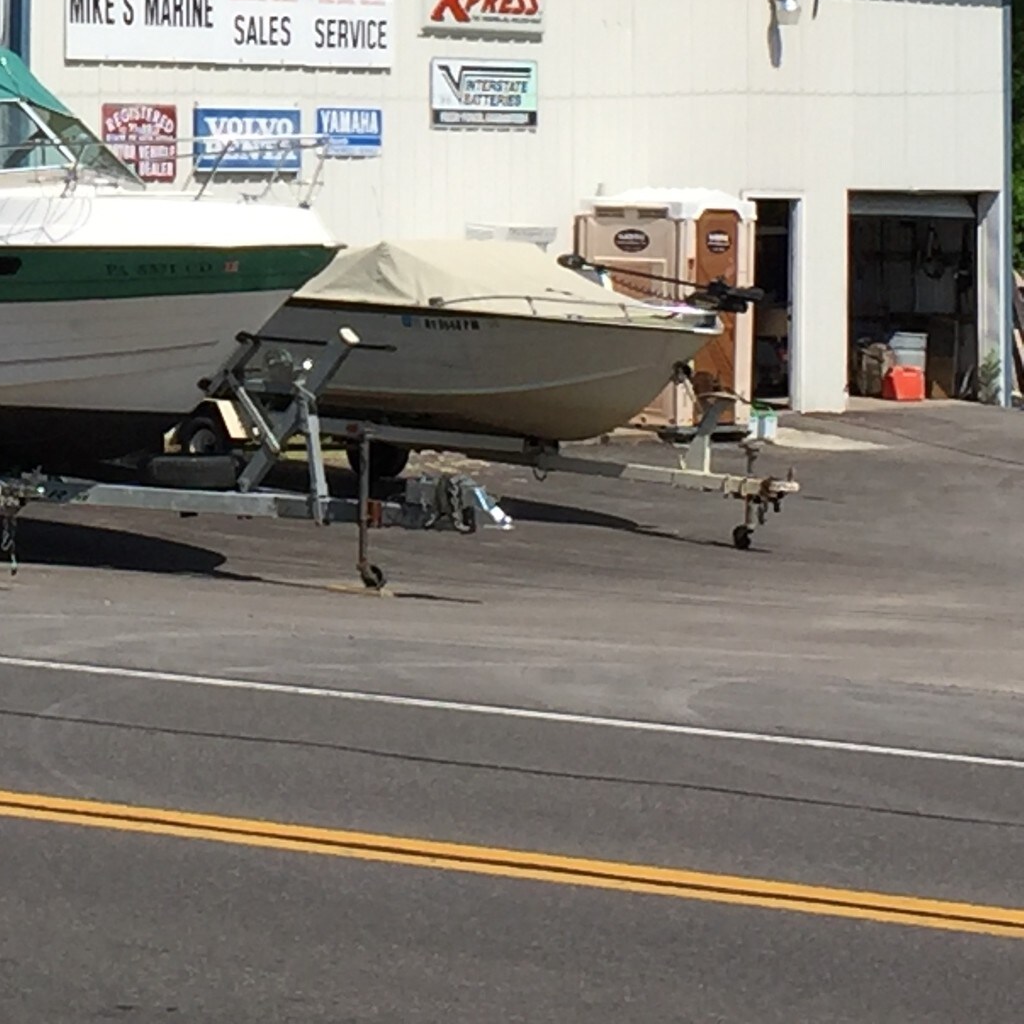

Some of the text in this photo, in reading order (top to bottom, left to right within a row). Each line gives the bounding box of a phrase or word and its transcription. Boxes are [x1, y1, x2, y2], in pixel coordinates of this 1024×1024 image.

[233, 14, 388, 50] SALES SERVICE
[463, 80, 528, 94] INTERSTATE
[462, 93, 522, 107] BATTERIES
[105, 106, 174, 133] REGISTERED
[204, 117, 294, 138] VOLVO
[319, 110, 379, 134] YAMAHA
[138, 161, 174, 177] DEALER
